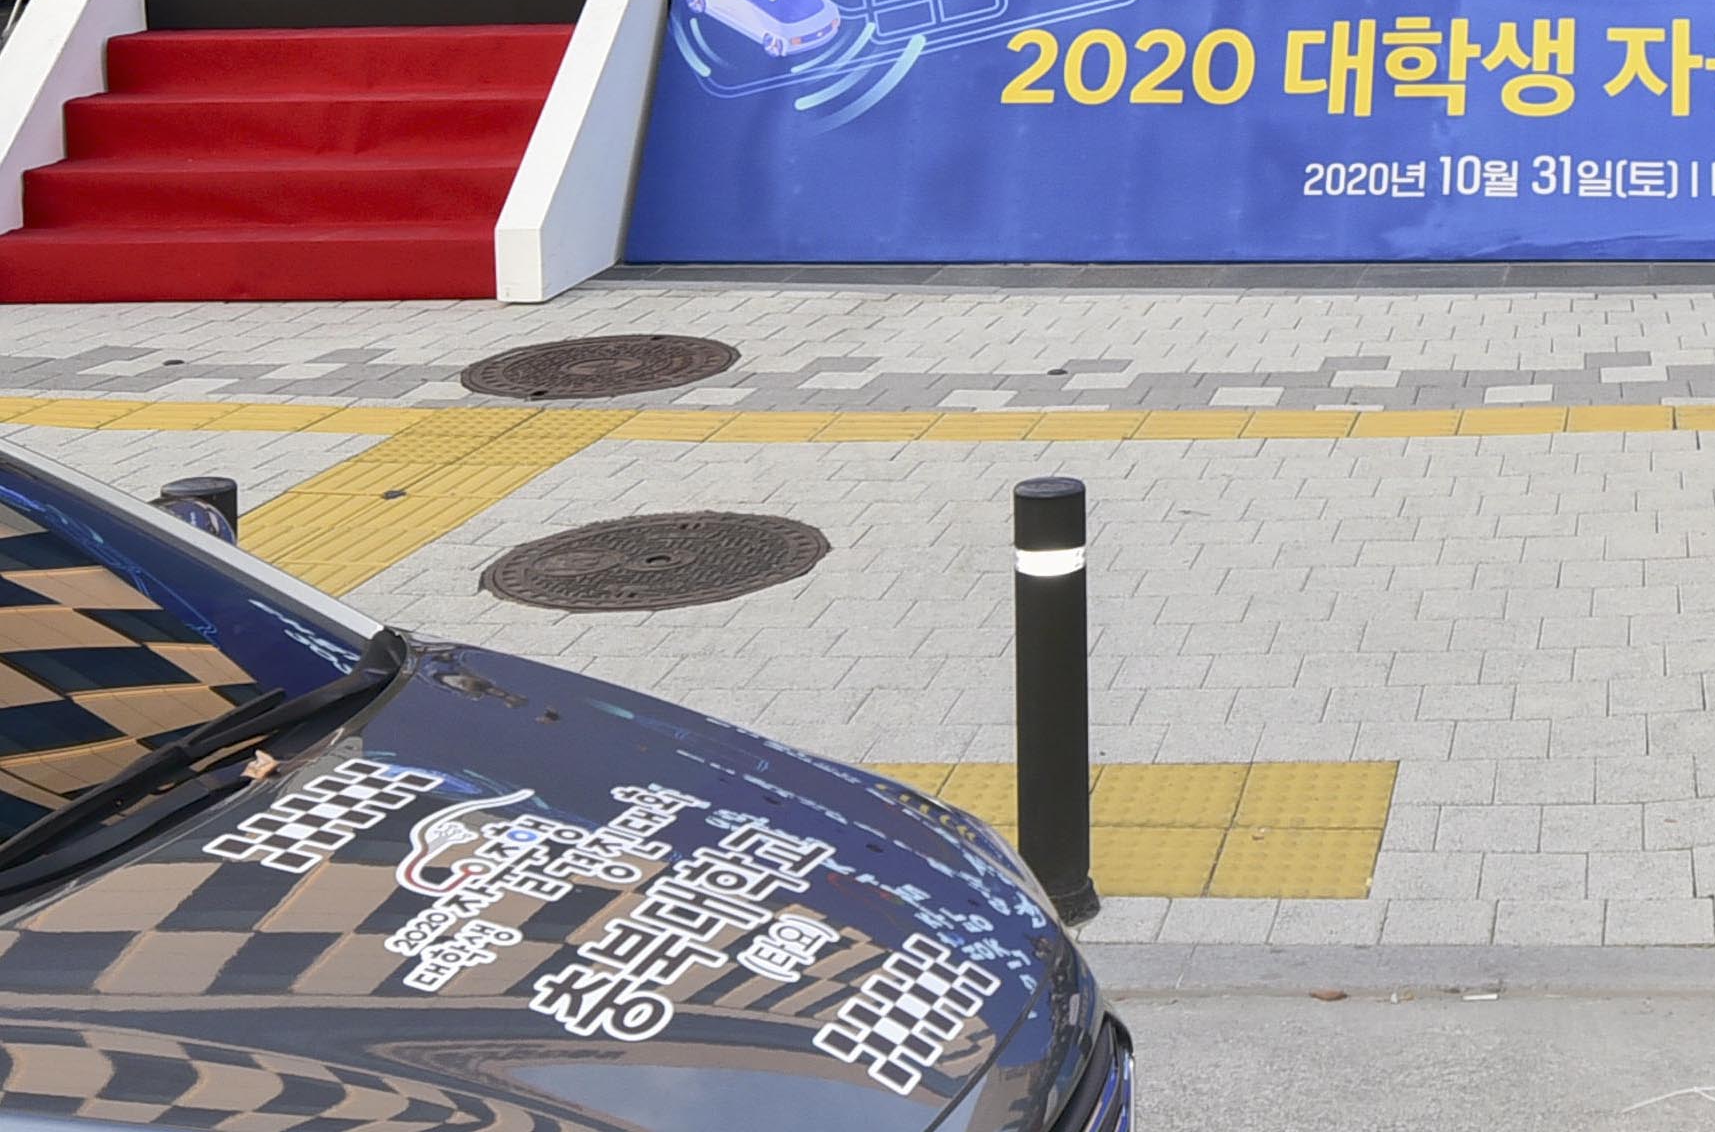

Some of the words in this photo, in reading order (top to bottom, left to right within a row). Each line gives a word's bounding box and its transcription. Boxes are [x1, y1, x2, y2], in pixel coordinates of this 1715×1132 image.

[1000, 26, 1256, 107] 2020
[1285, 15, 1577, 117] 대학생
[1303, 161, 1427, 199] 2020년
[1439, 156, 1520, 199] 10월
[1531, 156, 1681, 201] 31일(토)
[389, 910, 453, 953] 2020
[435, 816, 586, 918] 자율주행
[404, 922, 521, 992] 대학생
[557, 783, 711, 885] 경진대회
[531, 821, 836, 1039] 충북대학교
[739, 915, 839, 983] (타요)
